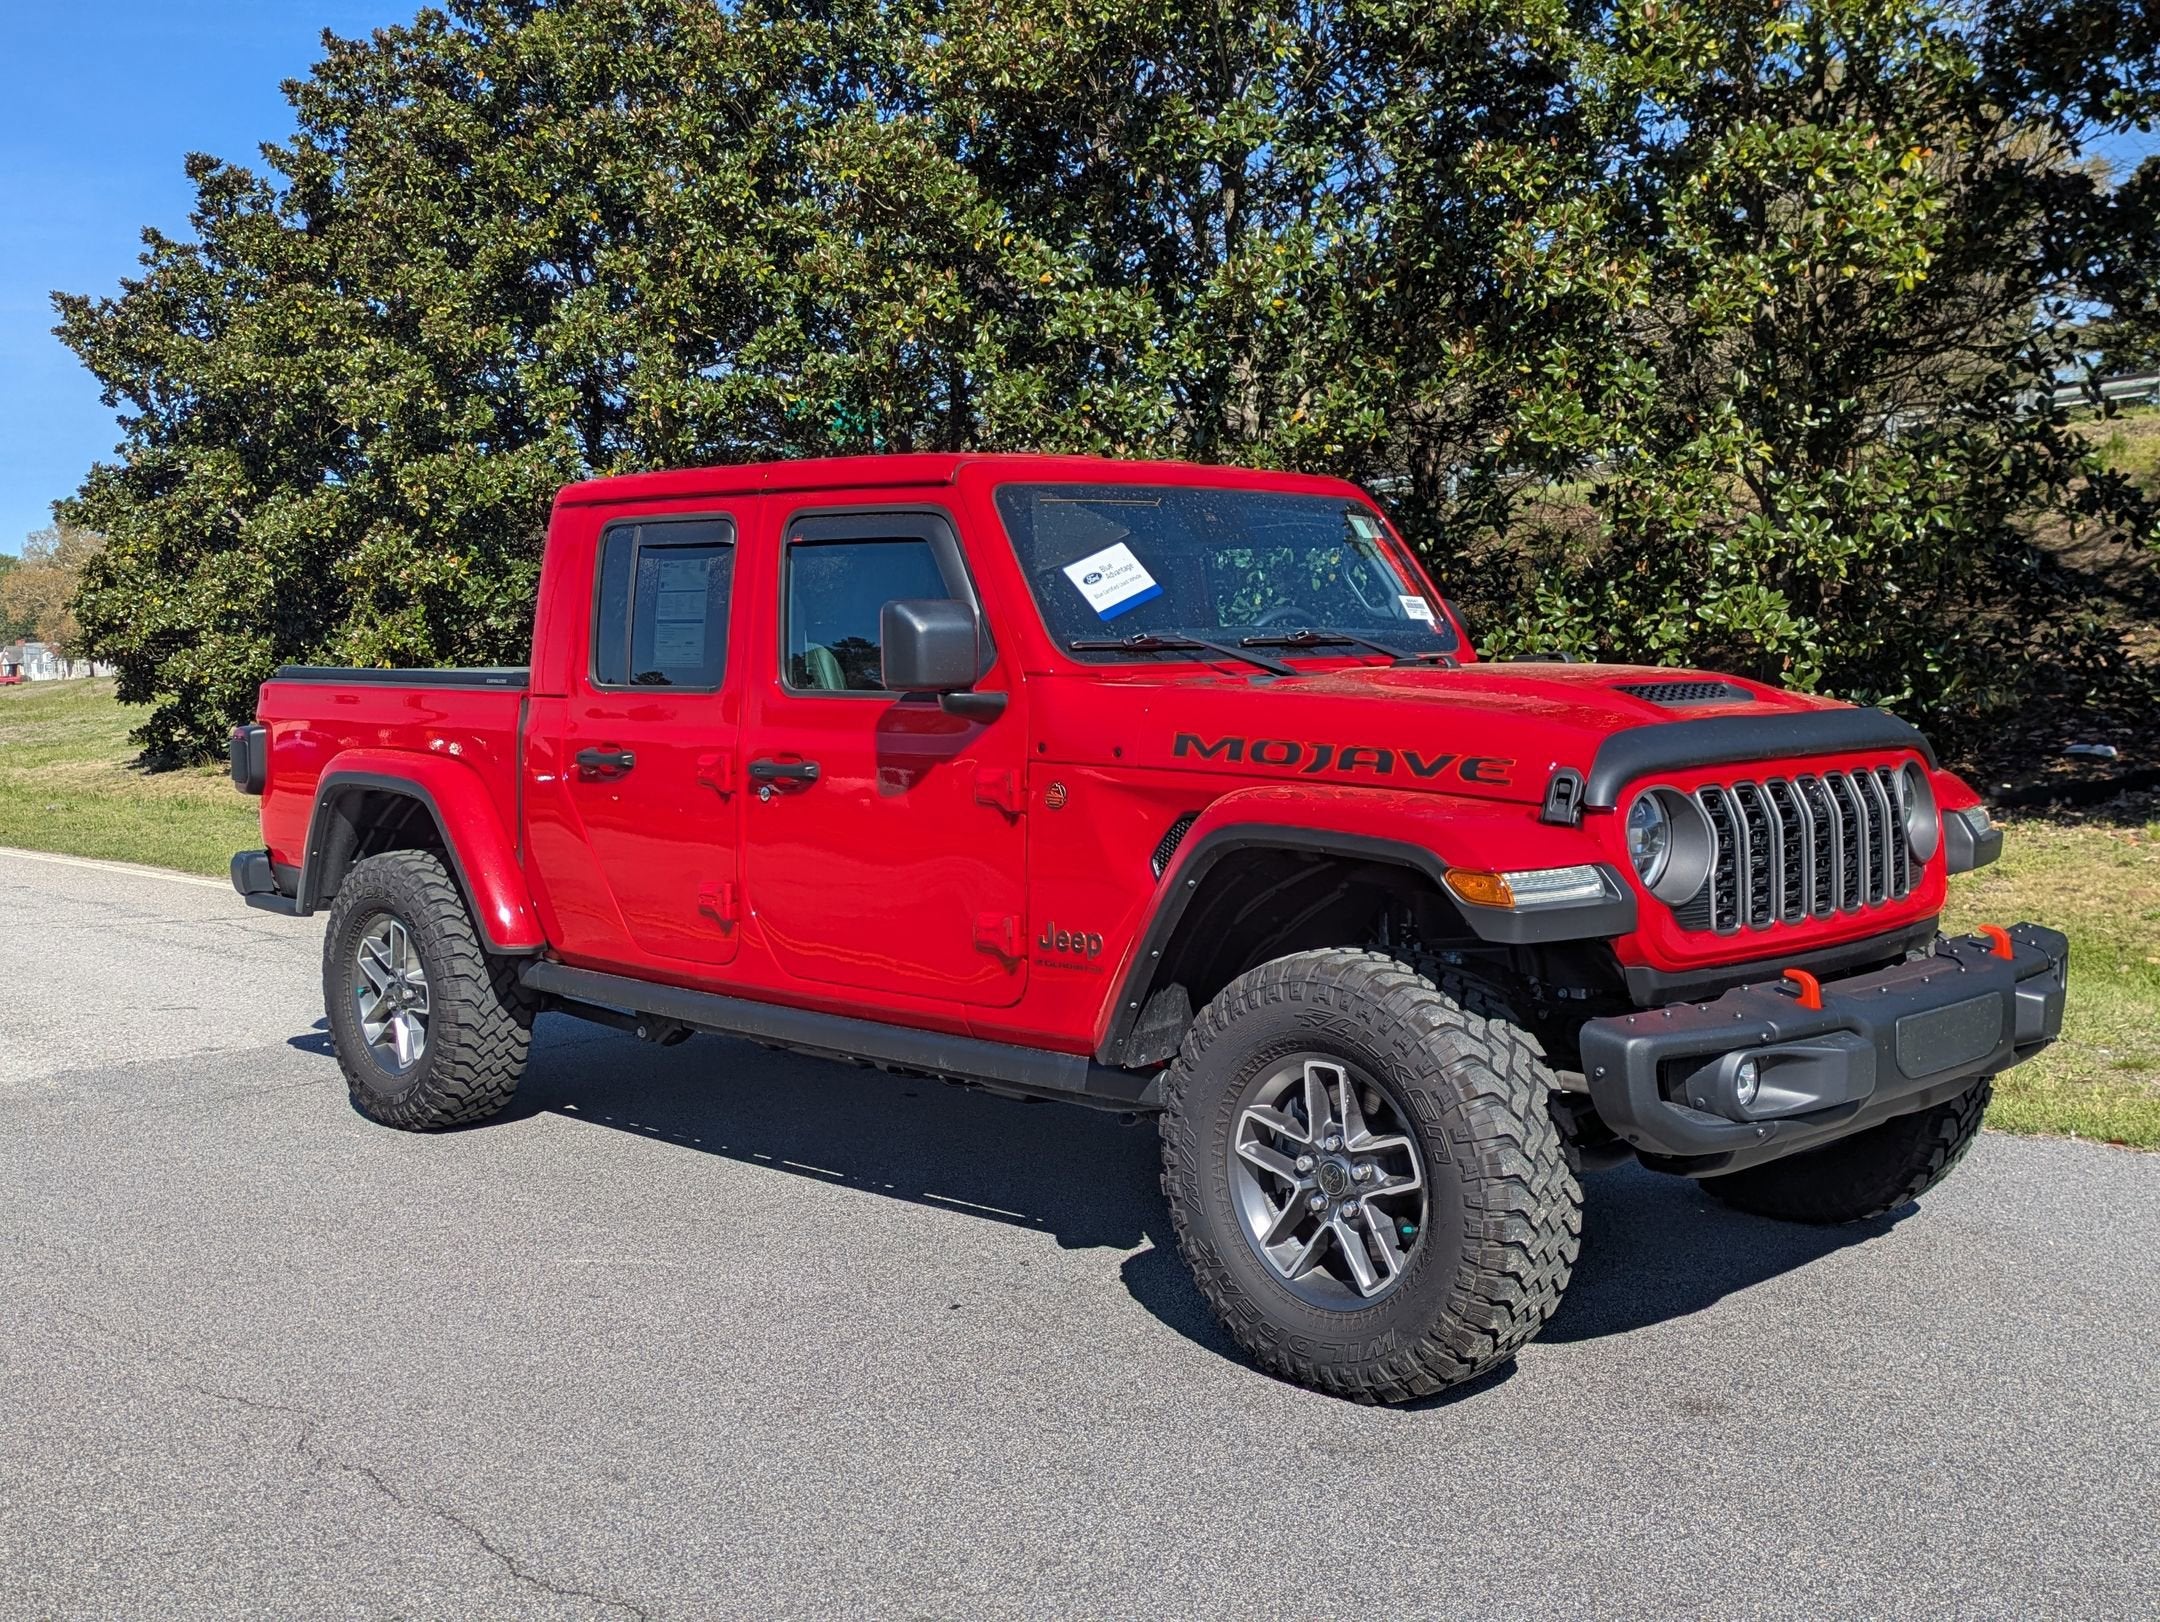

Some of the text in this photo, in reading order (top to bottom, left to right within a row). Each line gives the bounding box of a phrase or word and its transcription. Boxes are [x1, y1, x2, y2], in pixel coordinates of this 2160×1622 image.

[1084, 573, 1101, 585] Ford
[1099, 563, 1113, 573] Blue
[1105, 563, 1134, 579] Advantage
[1172, 731, 1517, 786] MOJAVE
[1038, 920, 1104, 961] Jeep
[1196, 1238, 1398, 1364] WILDPEAK
